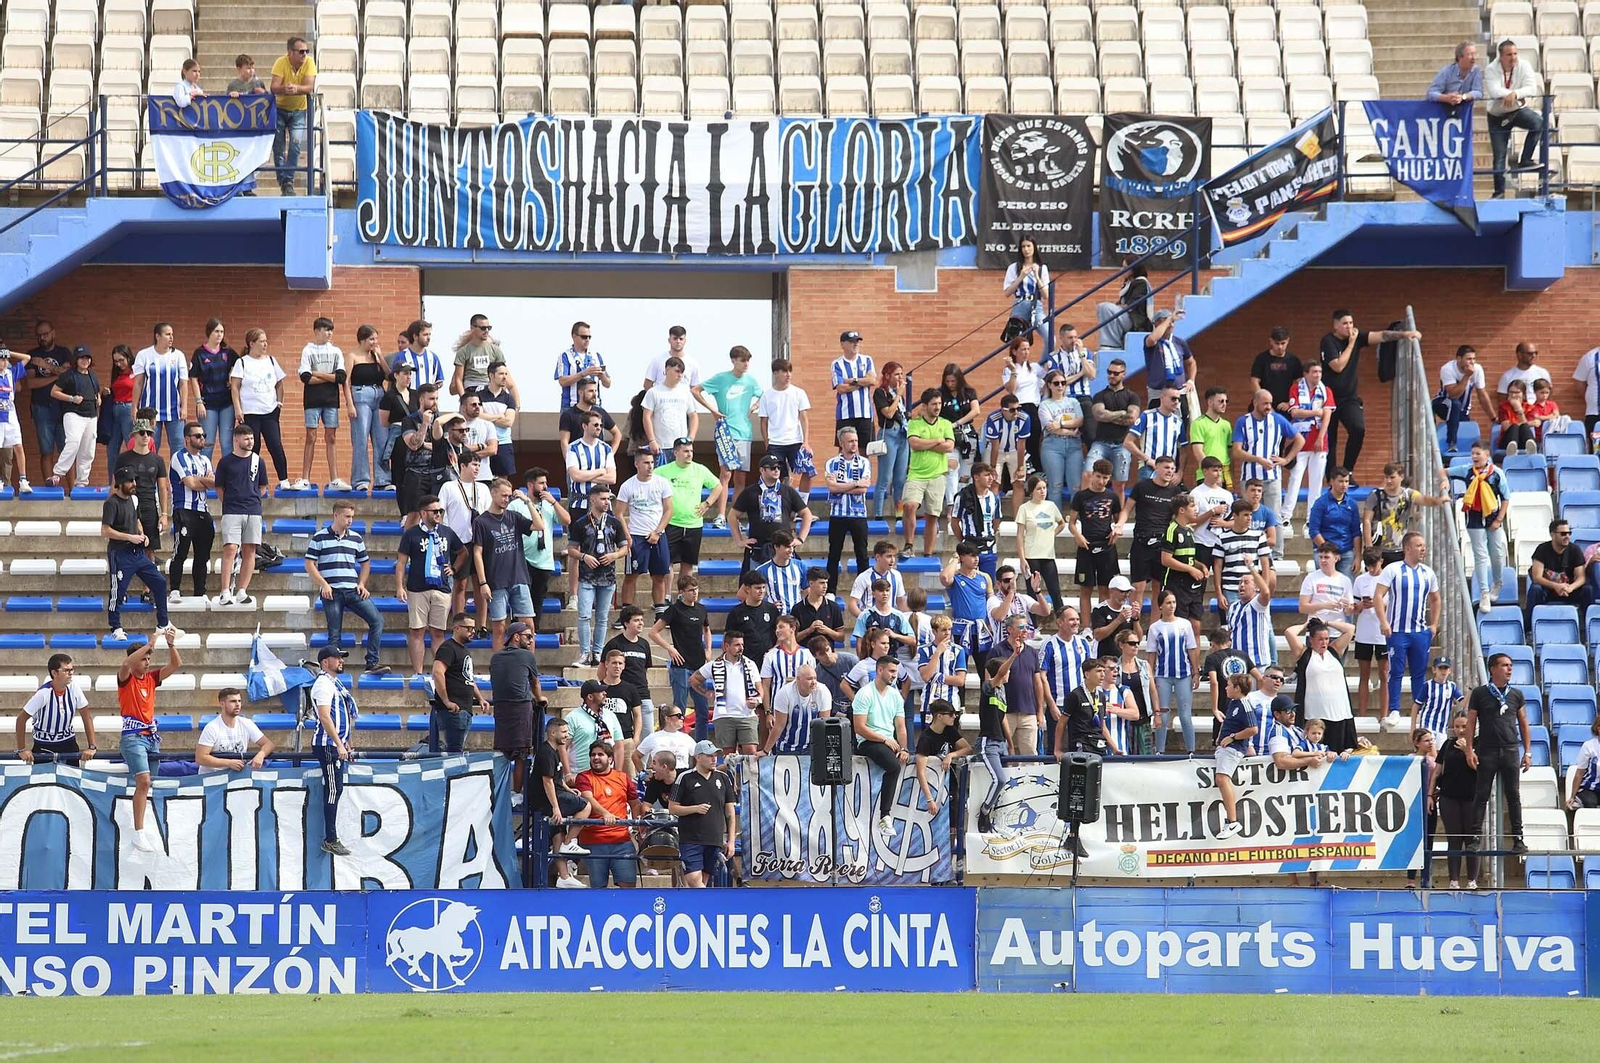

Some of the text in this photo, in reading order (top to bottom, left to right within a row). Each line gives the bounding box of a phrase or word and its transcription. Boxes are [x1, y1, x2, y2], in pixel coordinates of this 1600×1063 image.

[990, 119, 1088, 154] DICEN QUE ESTAMOS
[1370, 118, 1465, 159] GANG
[359, 110, 978, 253] JUNTOS HACIA LA GLORIA
[990, 157, 1015, 184] LOCOS
[1016, 180, 1032, 190] DE
[1034, 182, 1050, 192] LA
[1051, 160, 1087, 189] CABEZA
[1398, 159, 1464, 182] HUELVA
[998, 201, 1068, 210] PERO ESO
[991, 222, 1072, 232] AL DECANO
[984, 244, 1006, 252] NO
[1116, 234, 1187, 260] 1889
[1197, 763, 1309, 789] SCTOR
[742, 755, 872, 884] 1889
[752, 850, 867, 877] Forza Recre
[1032, 854, 1052, 865] Gol
[1156, 852, 1212, 865] DECANO
[1217, 851, 1243, 863] DEL
[1250, 846, 1301, 862] FÚTBOL
[1308, 844, 1371, 858] ESPAÑOL
[0, 894, 337, 946] EL MARTÍN
[500, 912, 958, 970] ATRACCIONES LA CINTA
[990, 916, 1576, 979] Autoparts Huelva
[134, 946, 358, 996] PINZÓN
